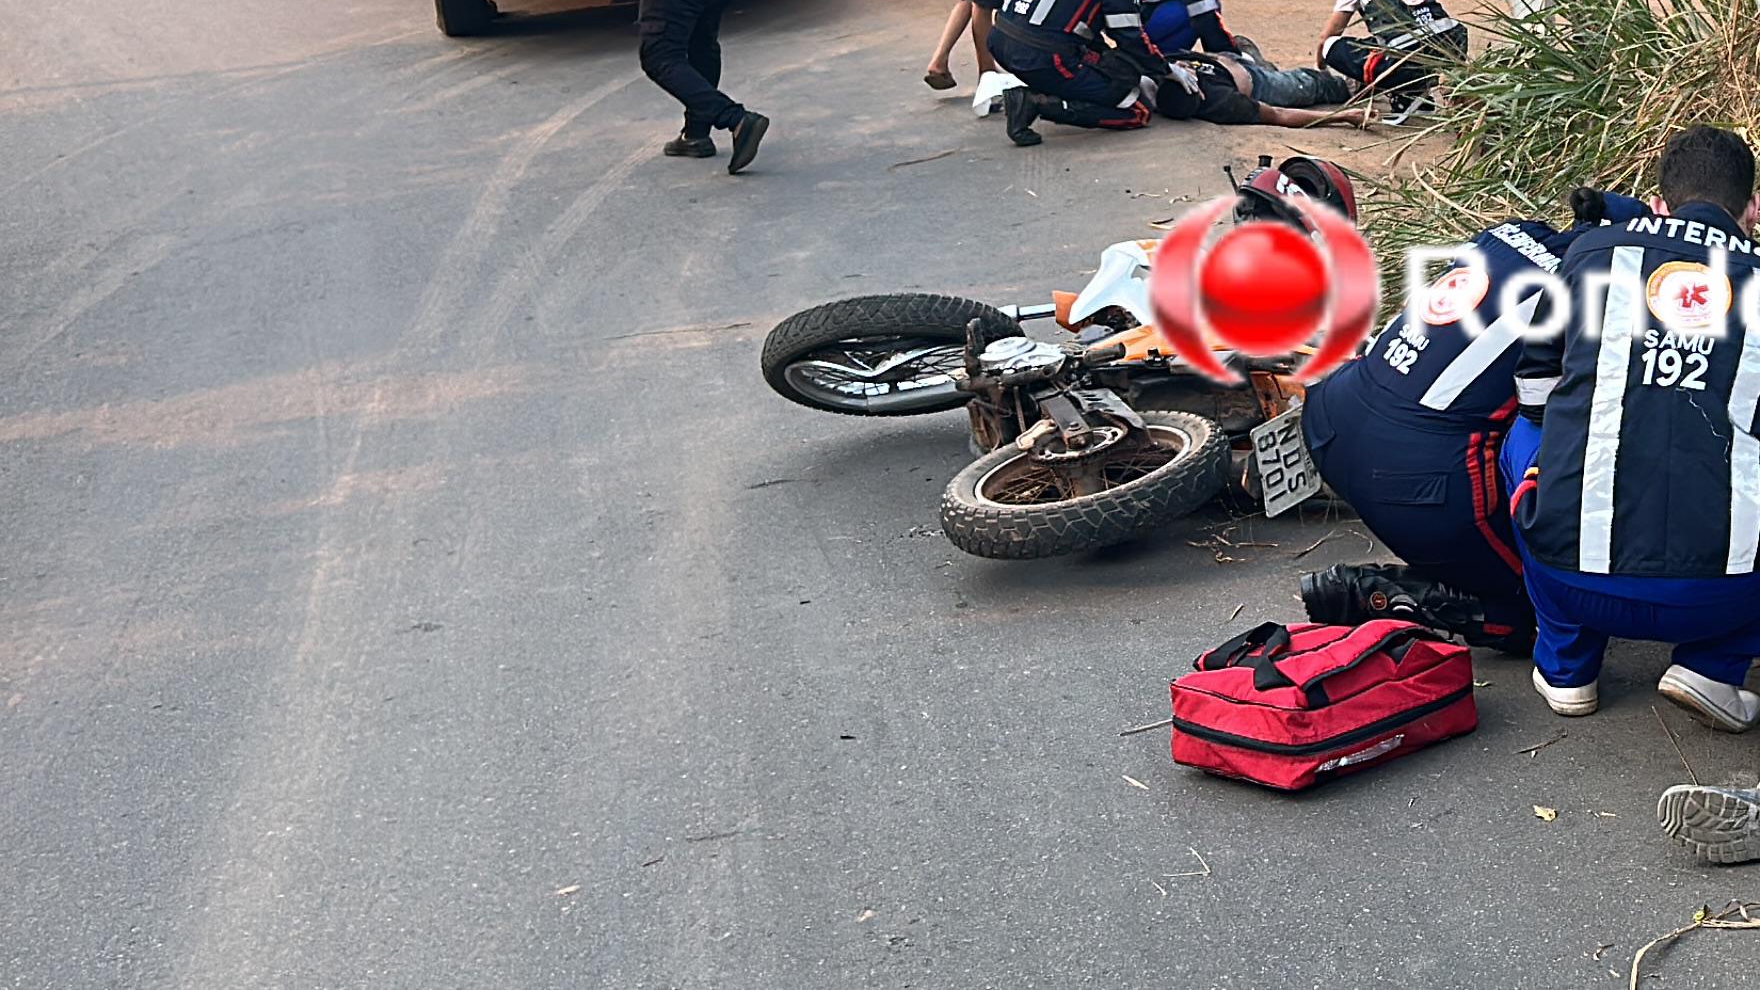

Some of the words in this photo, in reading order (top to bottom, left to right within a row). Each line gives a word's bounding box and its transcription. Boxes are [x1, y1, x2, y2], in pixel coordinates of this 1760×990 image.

[1399, 324, 1429, 351] SAMU
[1643, 329, 1715, 355] SAMU
[1383, 338, 1418, 375] 192
[1641, 348, 1709, 390] 192
[1277, 417, 1307, 493] NDS
